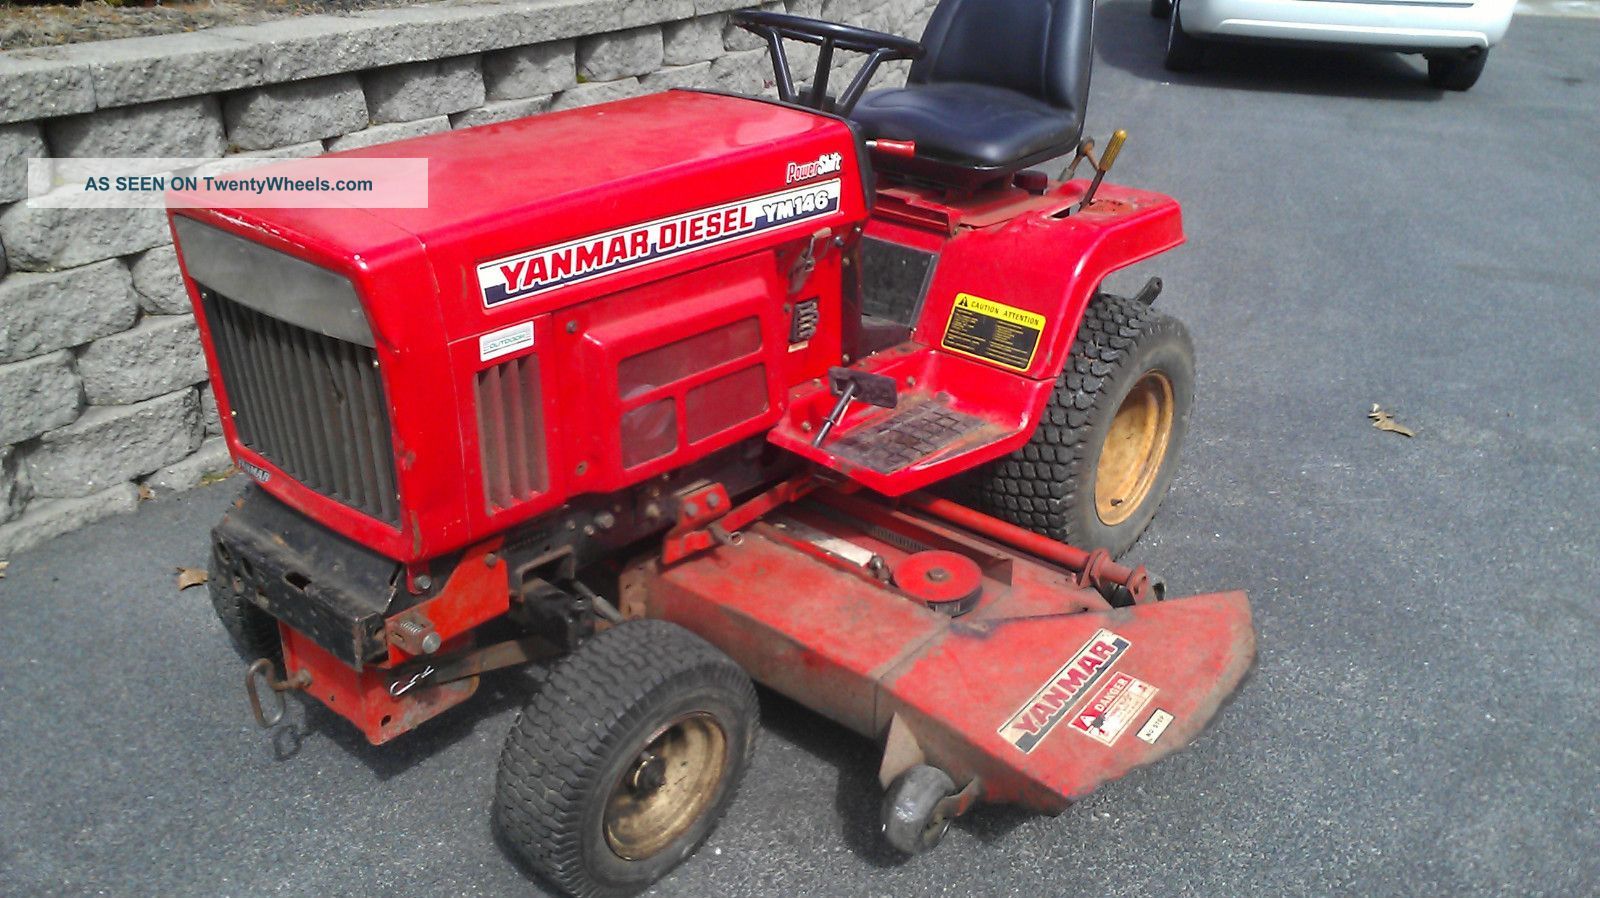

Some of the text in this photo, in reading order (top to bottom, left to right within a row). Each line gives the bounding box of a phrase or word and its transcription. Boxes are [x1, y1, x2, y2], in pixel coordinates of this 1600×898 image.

[786, 152, 842, 184] PowerShift
[500, 189, 830, 292] YANMAR DIESEL YM146
[970, 300, 1040, 326] CAUTION ATTENTION
[1011, 639, 1116, 735] YANMAR
[1093, 678, 1129, 712] DANGER
